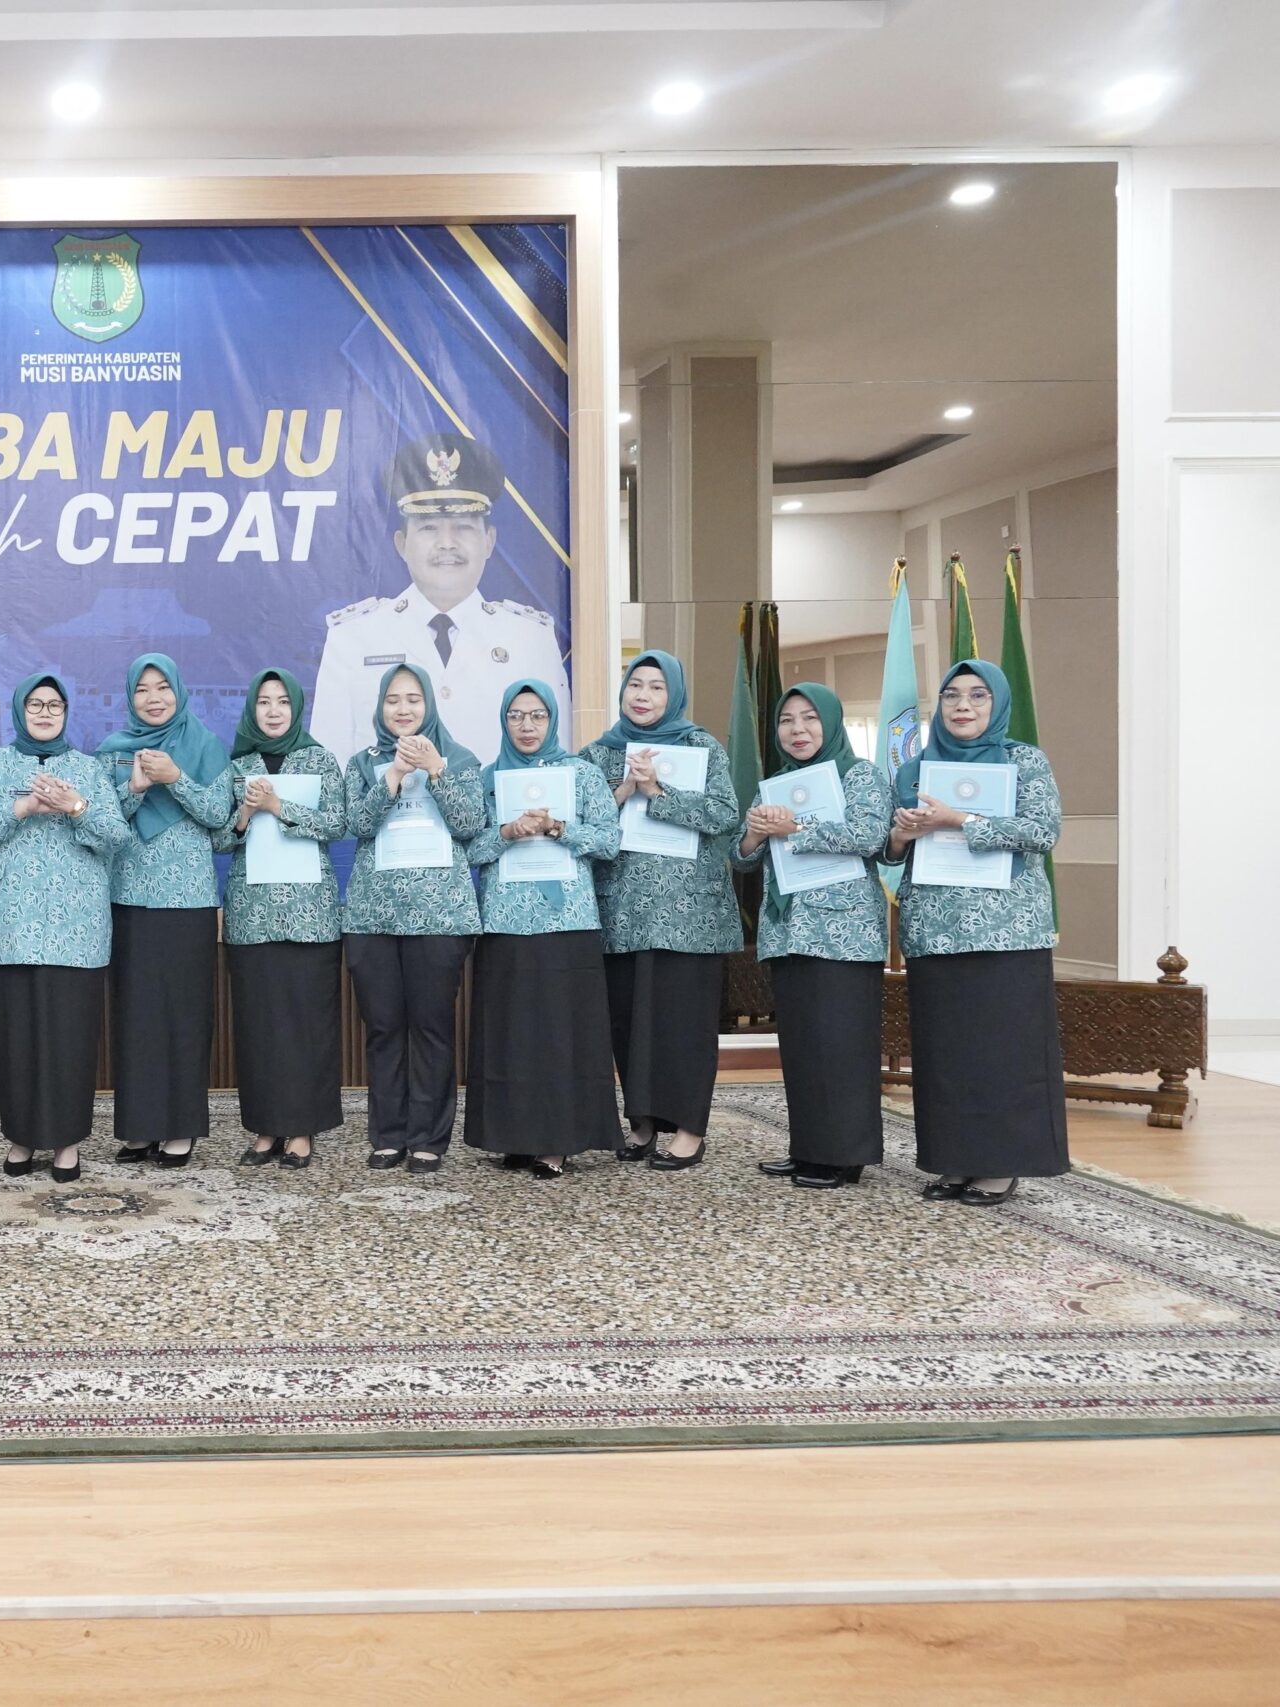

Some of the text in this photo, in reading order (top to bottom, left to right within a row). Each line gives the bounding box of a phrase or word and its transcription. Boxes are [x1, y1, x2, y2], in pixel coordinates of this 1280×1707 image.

[21, 352, 181, 365] PEMERINTAH KABUPATEN
[20, 365, 182, 383] MUSI BANYUASIN
[101, 409, 343, 479] MAJU
[56, 491, 337, 565] CEPAT
[397, 801, 423, 810] PKK
